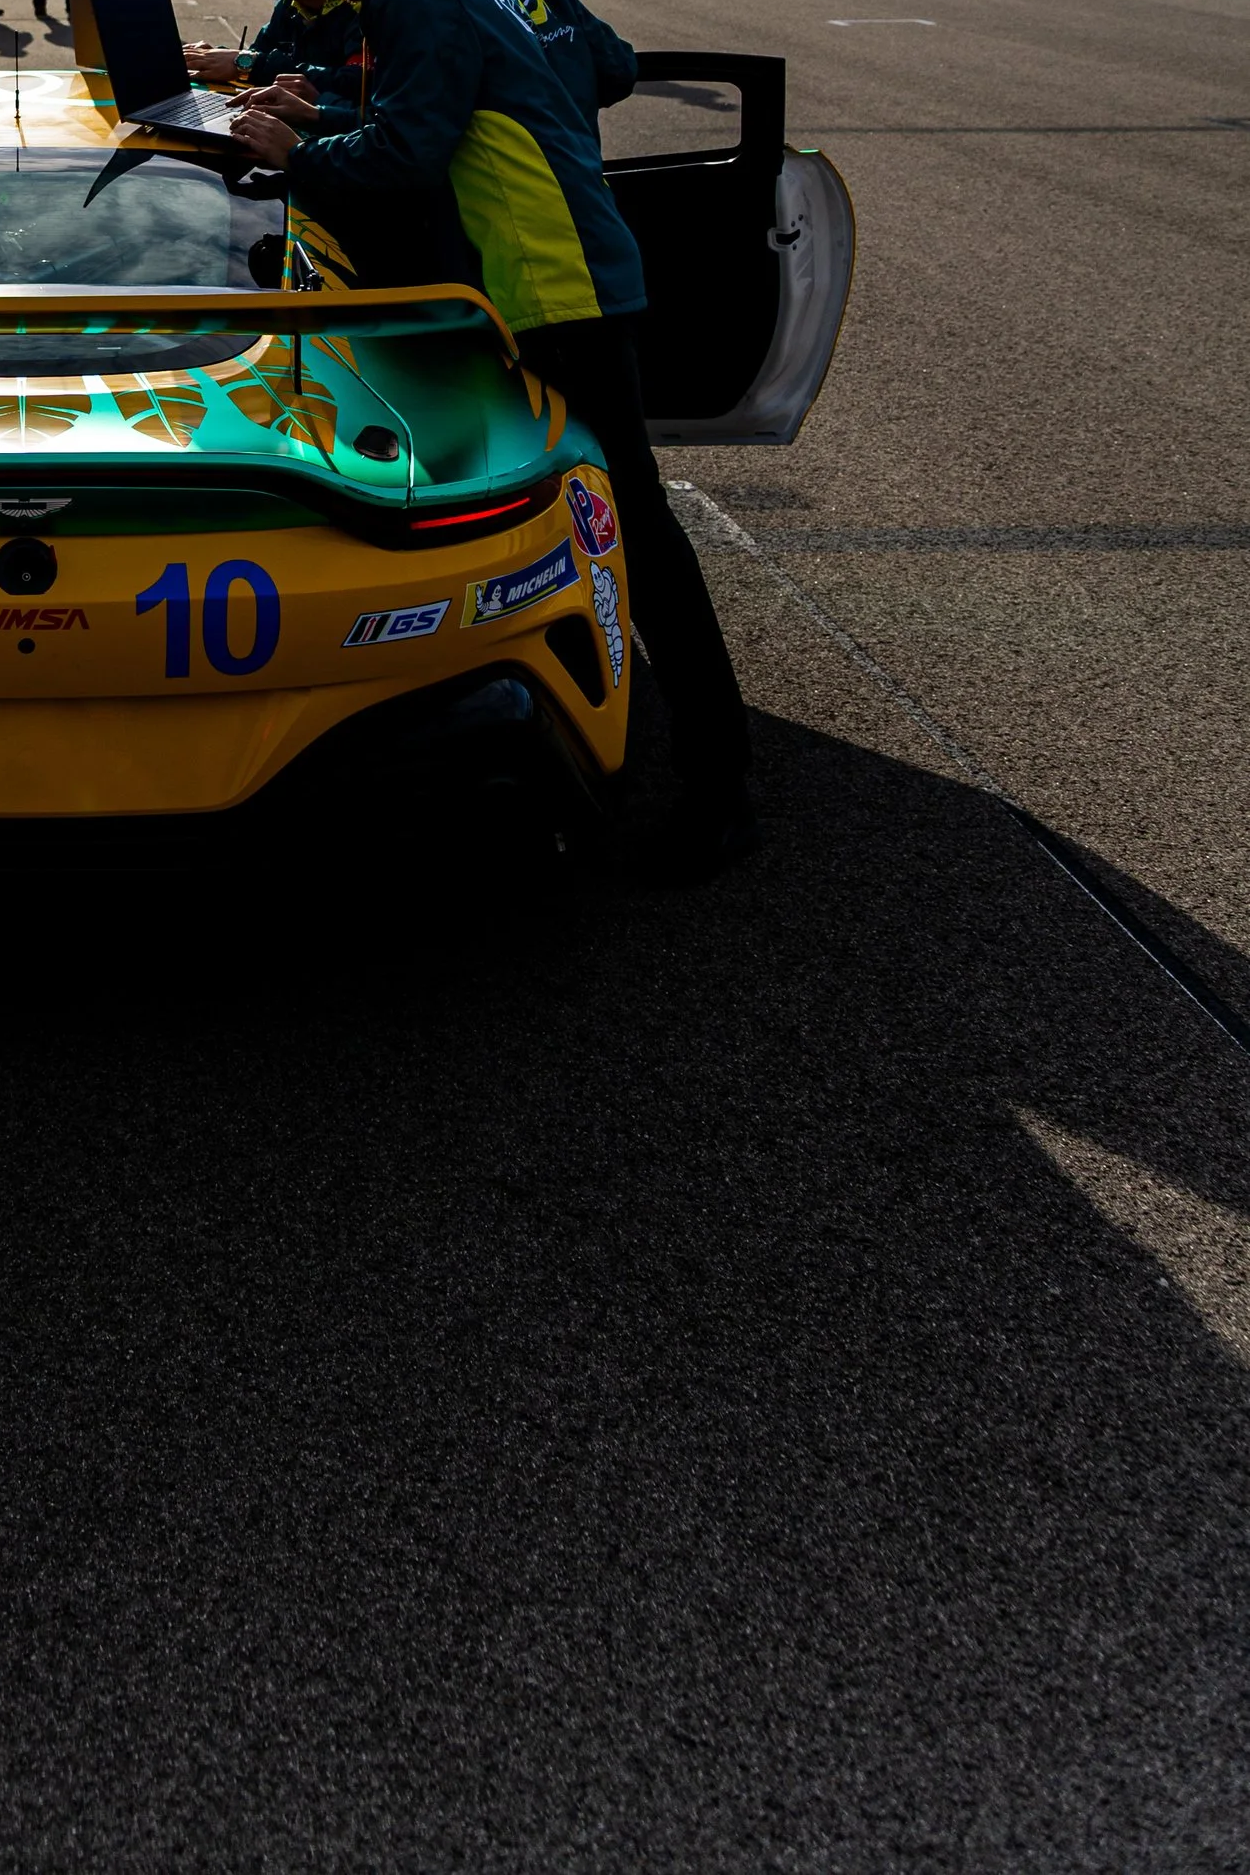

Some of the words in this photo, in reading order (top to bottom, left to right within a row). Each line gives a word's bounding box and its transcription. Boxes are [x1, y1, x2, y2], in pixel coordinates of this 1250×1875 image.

[565, 477, 602, 557] VP
[505, 556, 566, 604] MICHELIN
[134, 558, 282, 680] 10
[387, 608, 440, 635] GS
